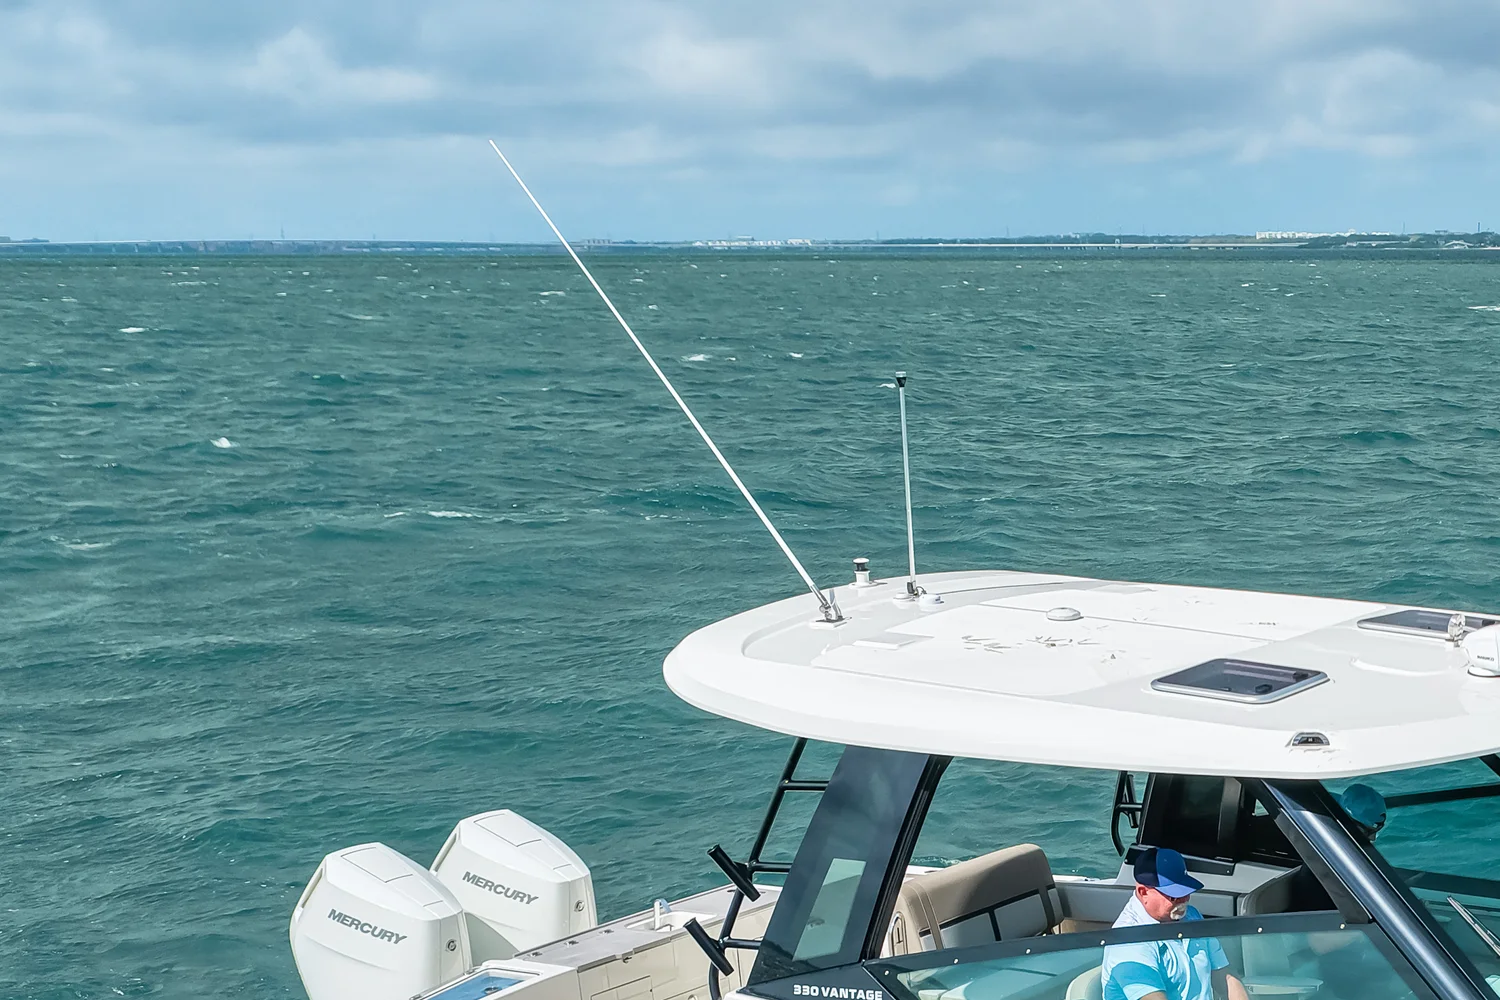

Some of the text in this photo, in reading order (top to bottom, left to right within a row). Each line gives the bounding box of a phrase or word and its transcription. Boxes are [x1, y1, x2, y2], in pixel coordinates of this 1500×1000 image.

[462, 871, 539, 905] MERCURY
[327, 908, 408, 945] MERCURY
[793, 984, 883, 1000] 330 VANTAGE
